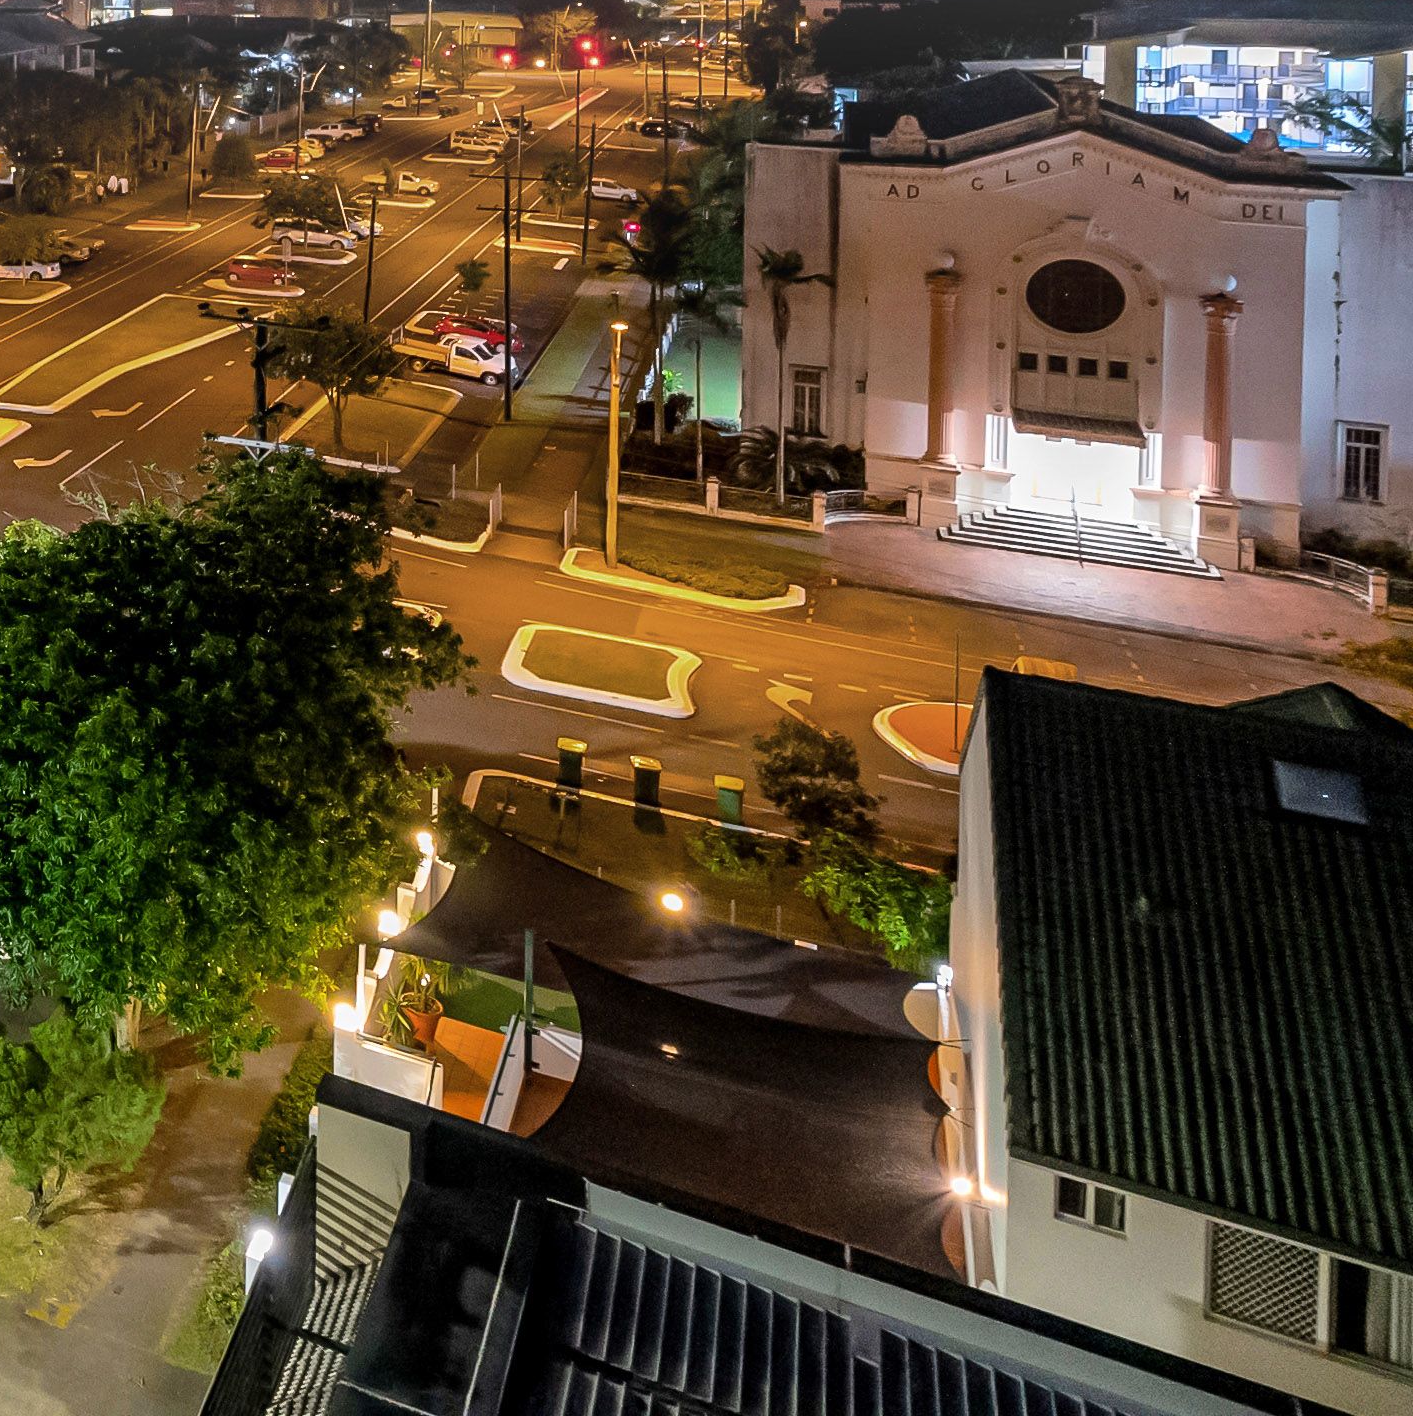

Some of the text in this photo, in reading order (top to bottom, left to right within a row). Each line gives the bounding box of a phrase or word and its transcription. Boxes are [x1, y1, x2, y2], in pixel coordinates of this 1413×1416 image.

[886, 152, 1284, 222] AD GLORIAM DEI
